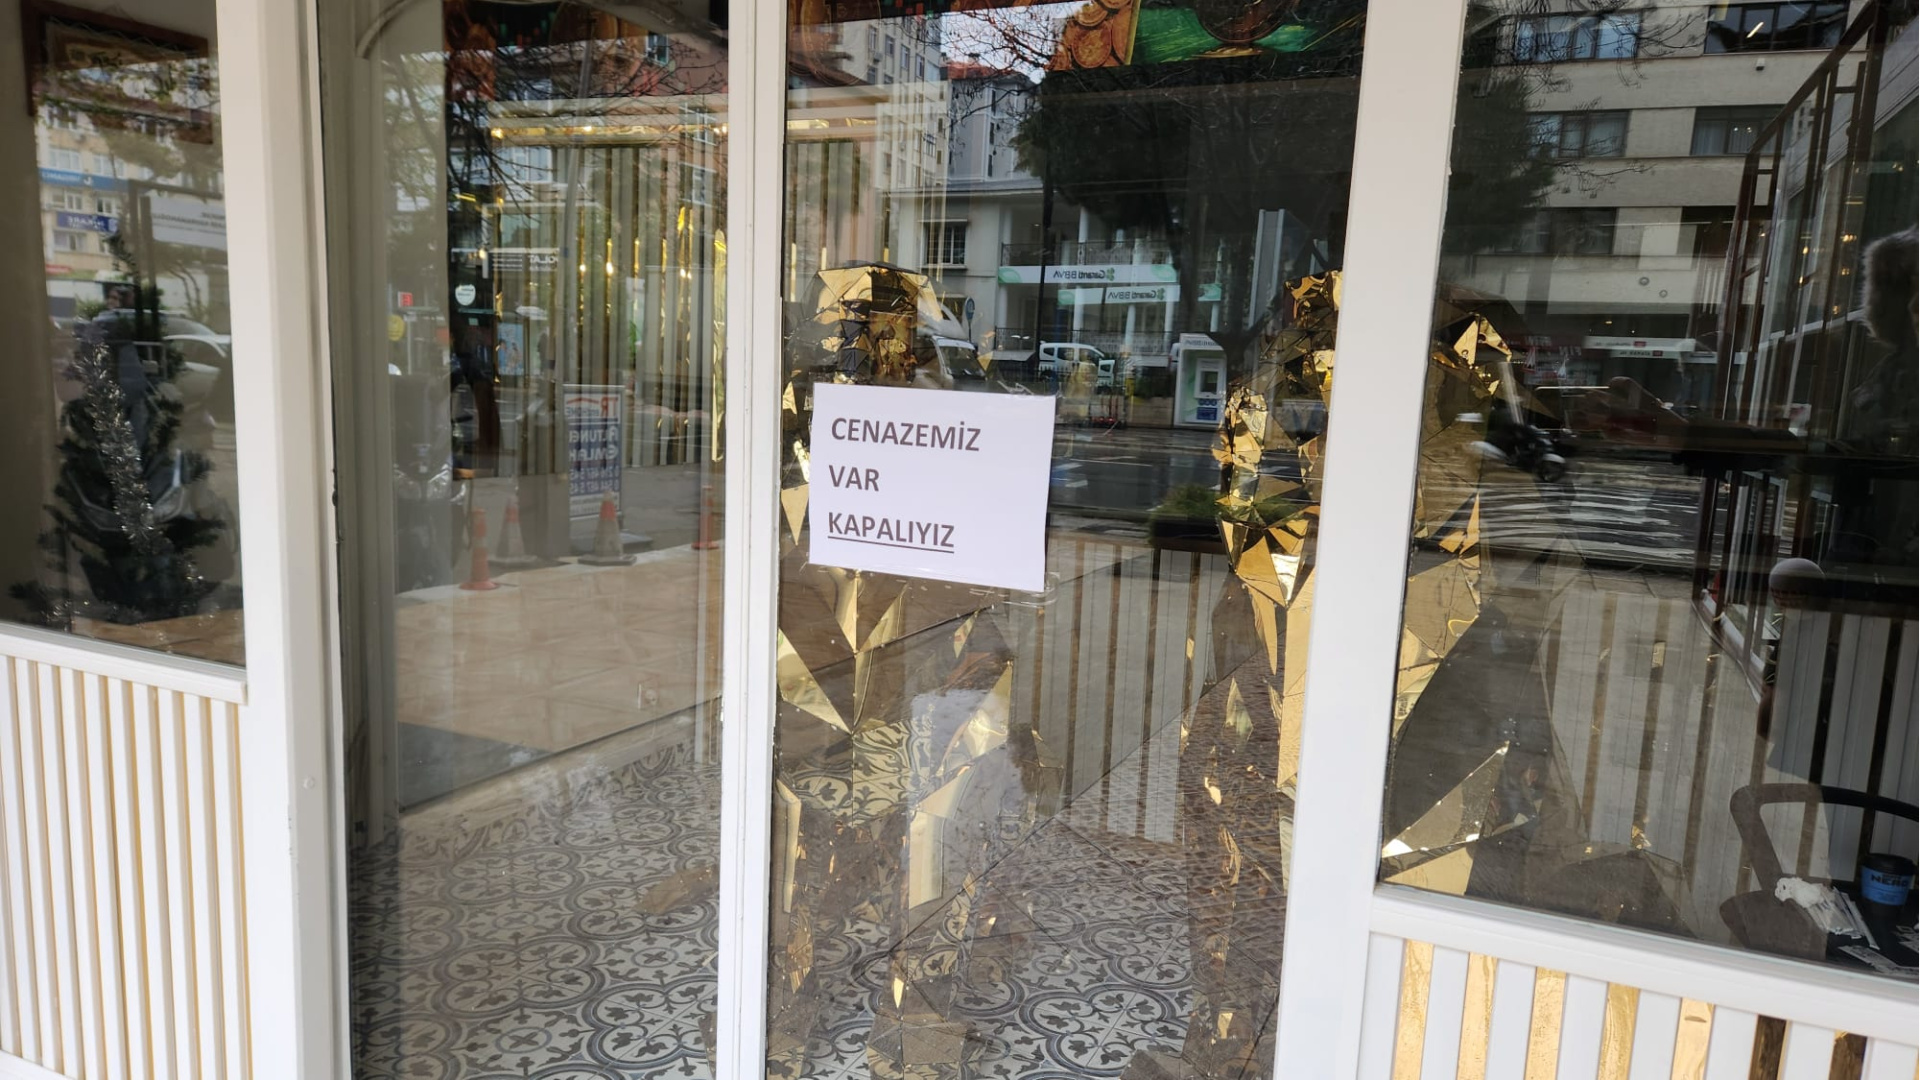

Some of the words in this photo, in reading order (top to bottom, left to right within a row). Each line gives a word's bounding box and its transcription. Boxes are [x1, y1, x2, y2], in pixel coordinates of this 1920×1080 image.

[831, 417, 982, 452] CENAZEMİZ
[828, 465, 880, 492] VAR
[828, 512, 955, 548] KAPALIYIZ
